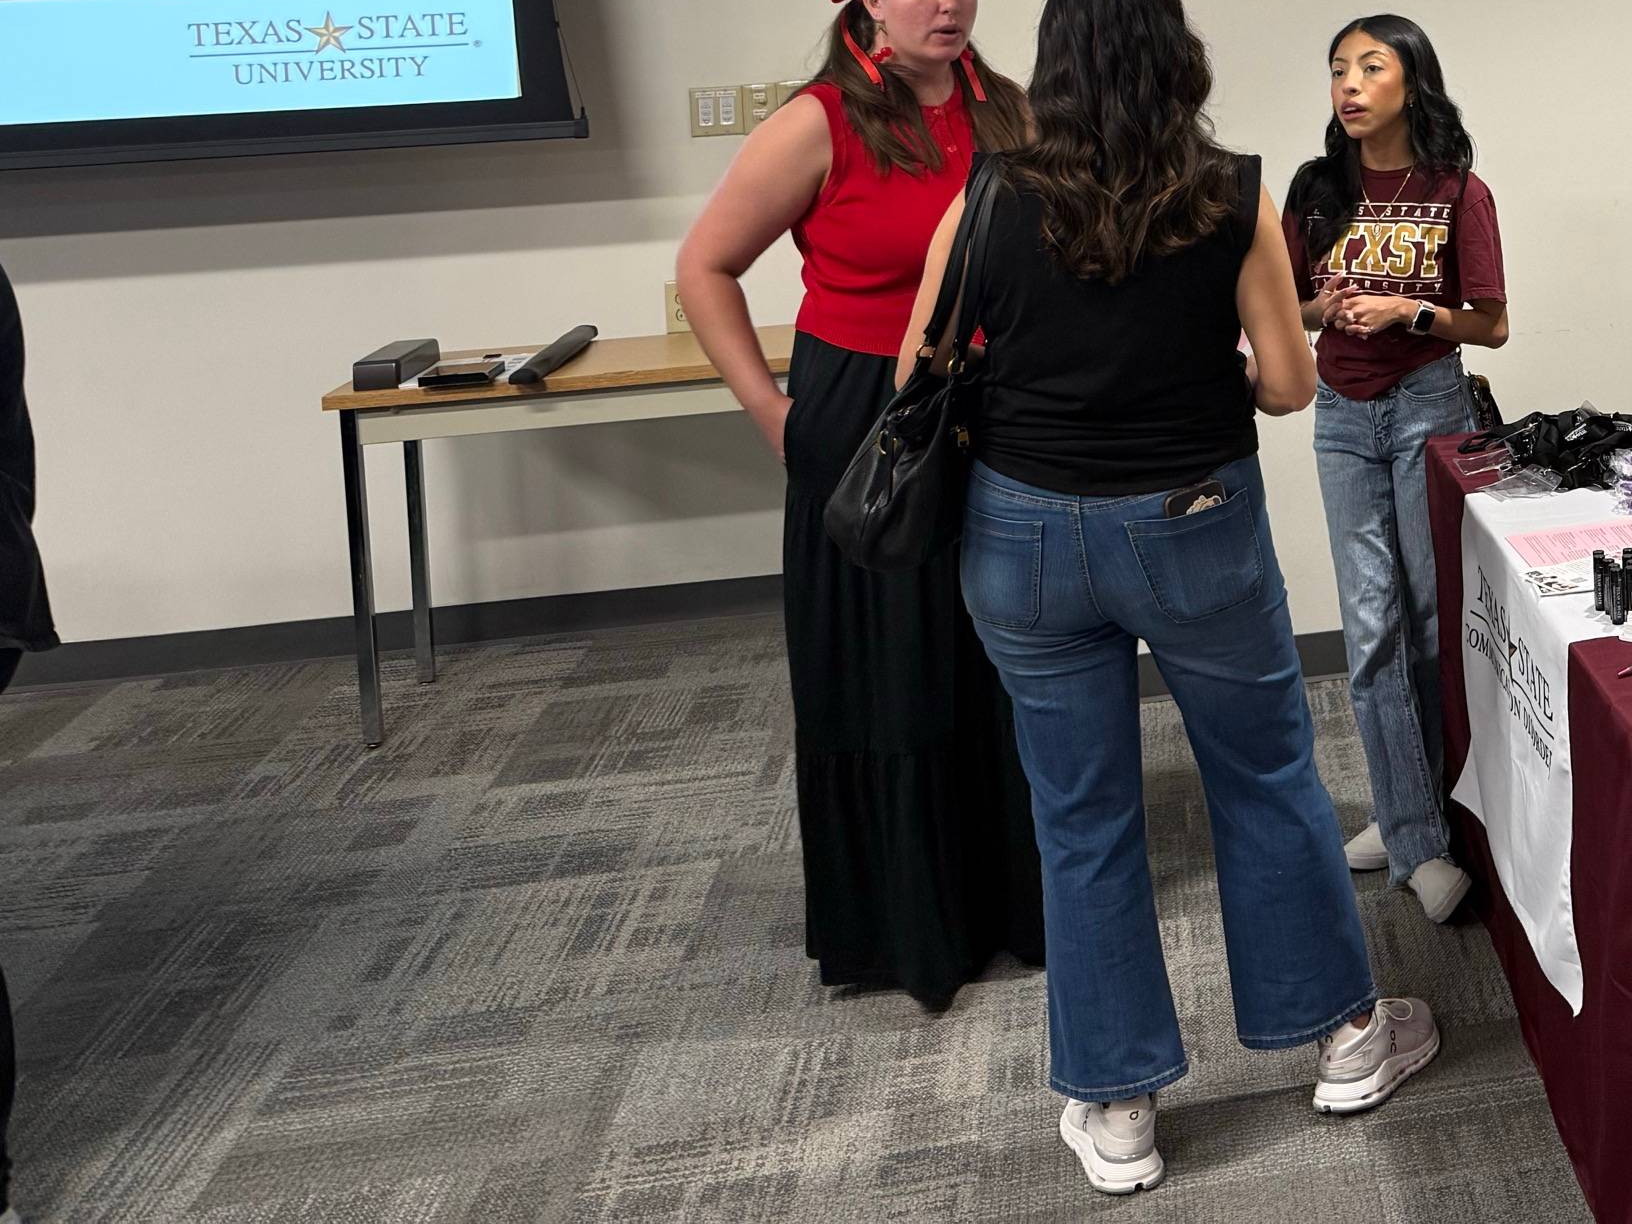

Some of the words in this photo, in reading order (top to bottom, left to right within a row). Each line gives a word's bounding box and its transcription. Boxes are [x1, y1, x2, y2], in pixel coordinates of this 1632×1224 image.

[187, 19, 303, 48] TEXAS
[357, 11, 469, 40] STATE
[232, 55, 430, 85] UNIVERSITY
[1327, 222, 1448, 278] TXST
[1518, 637, 1554, 722] STATE
